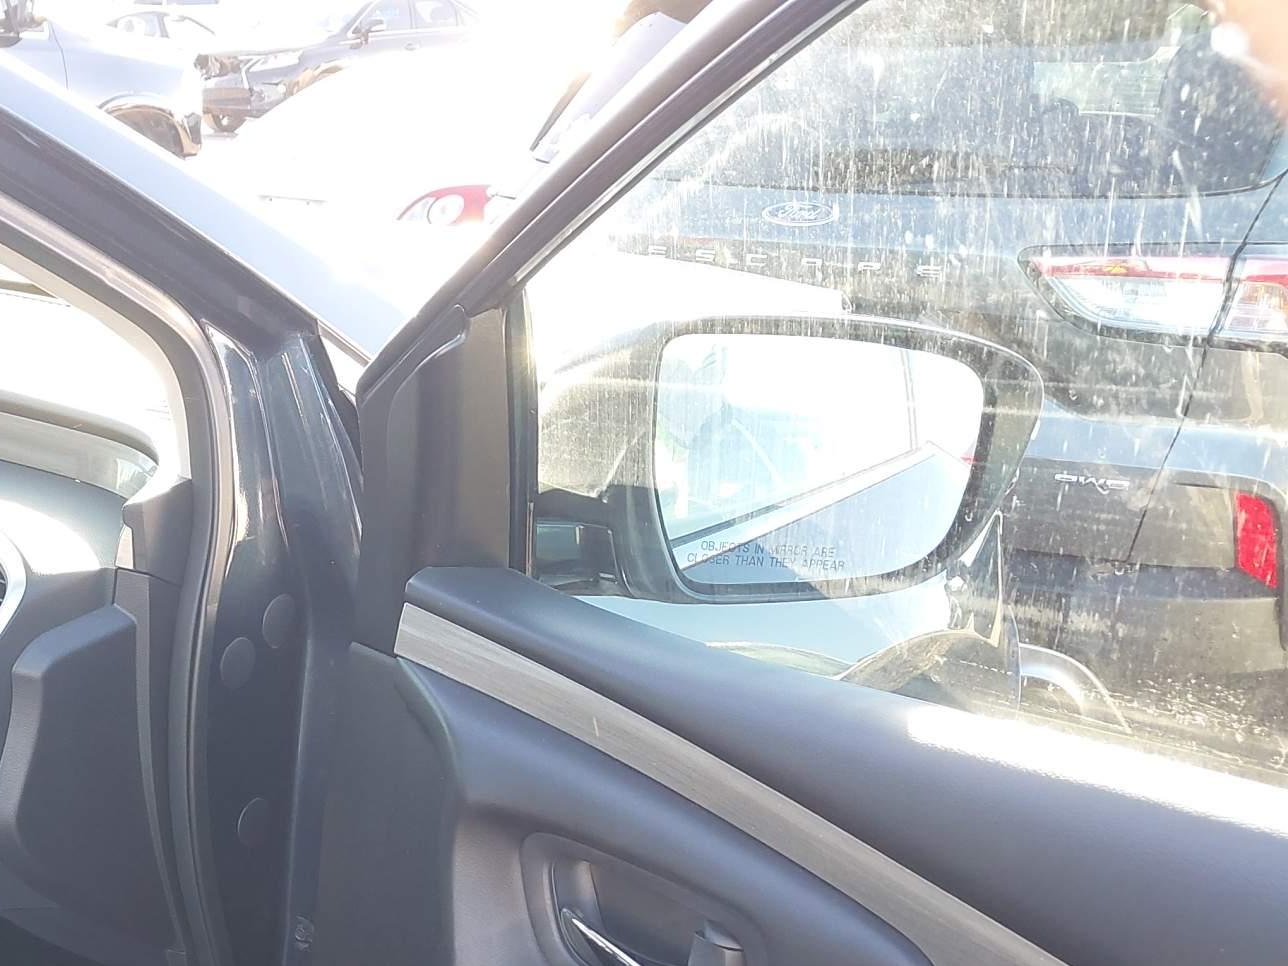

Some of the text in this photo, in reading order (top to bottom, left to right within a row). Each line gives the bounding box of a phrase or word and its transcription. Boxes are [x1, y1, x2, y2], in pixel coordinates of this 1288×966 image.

[701, 540, 836, 558] OBJECTS IN MIRROR ARE
[687, 552, 845, 571] CLOSER THAN THEY APPEAR
